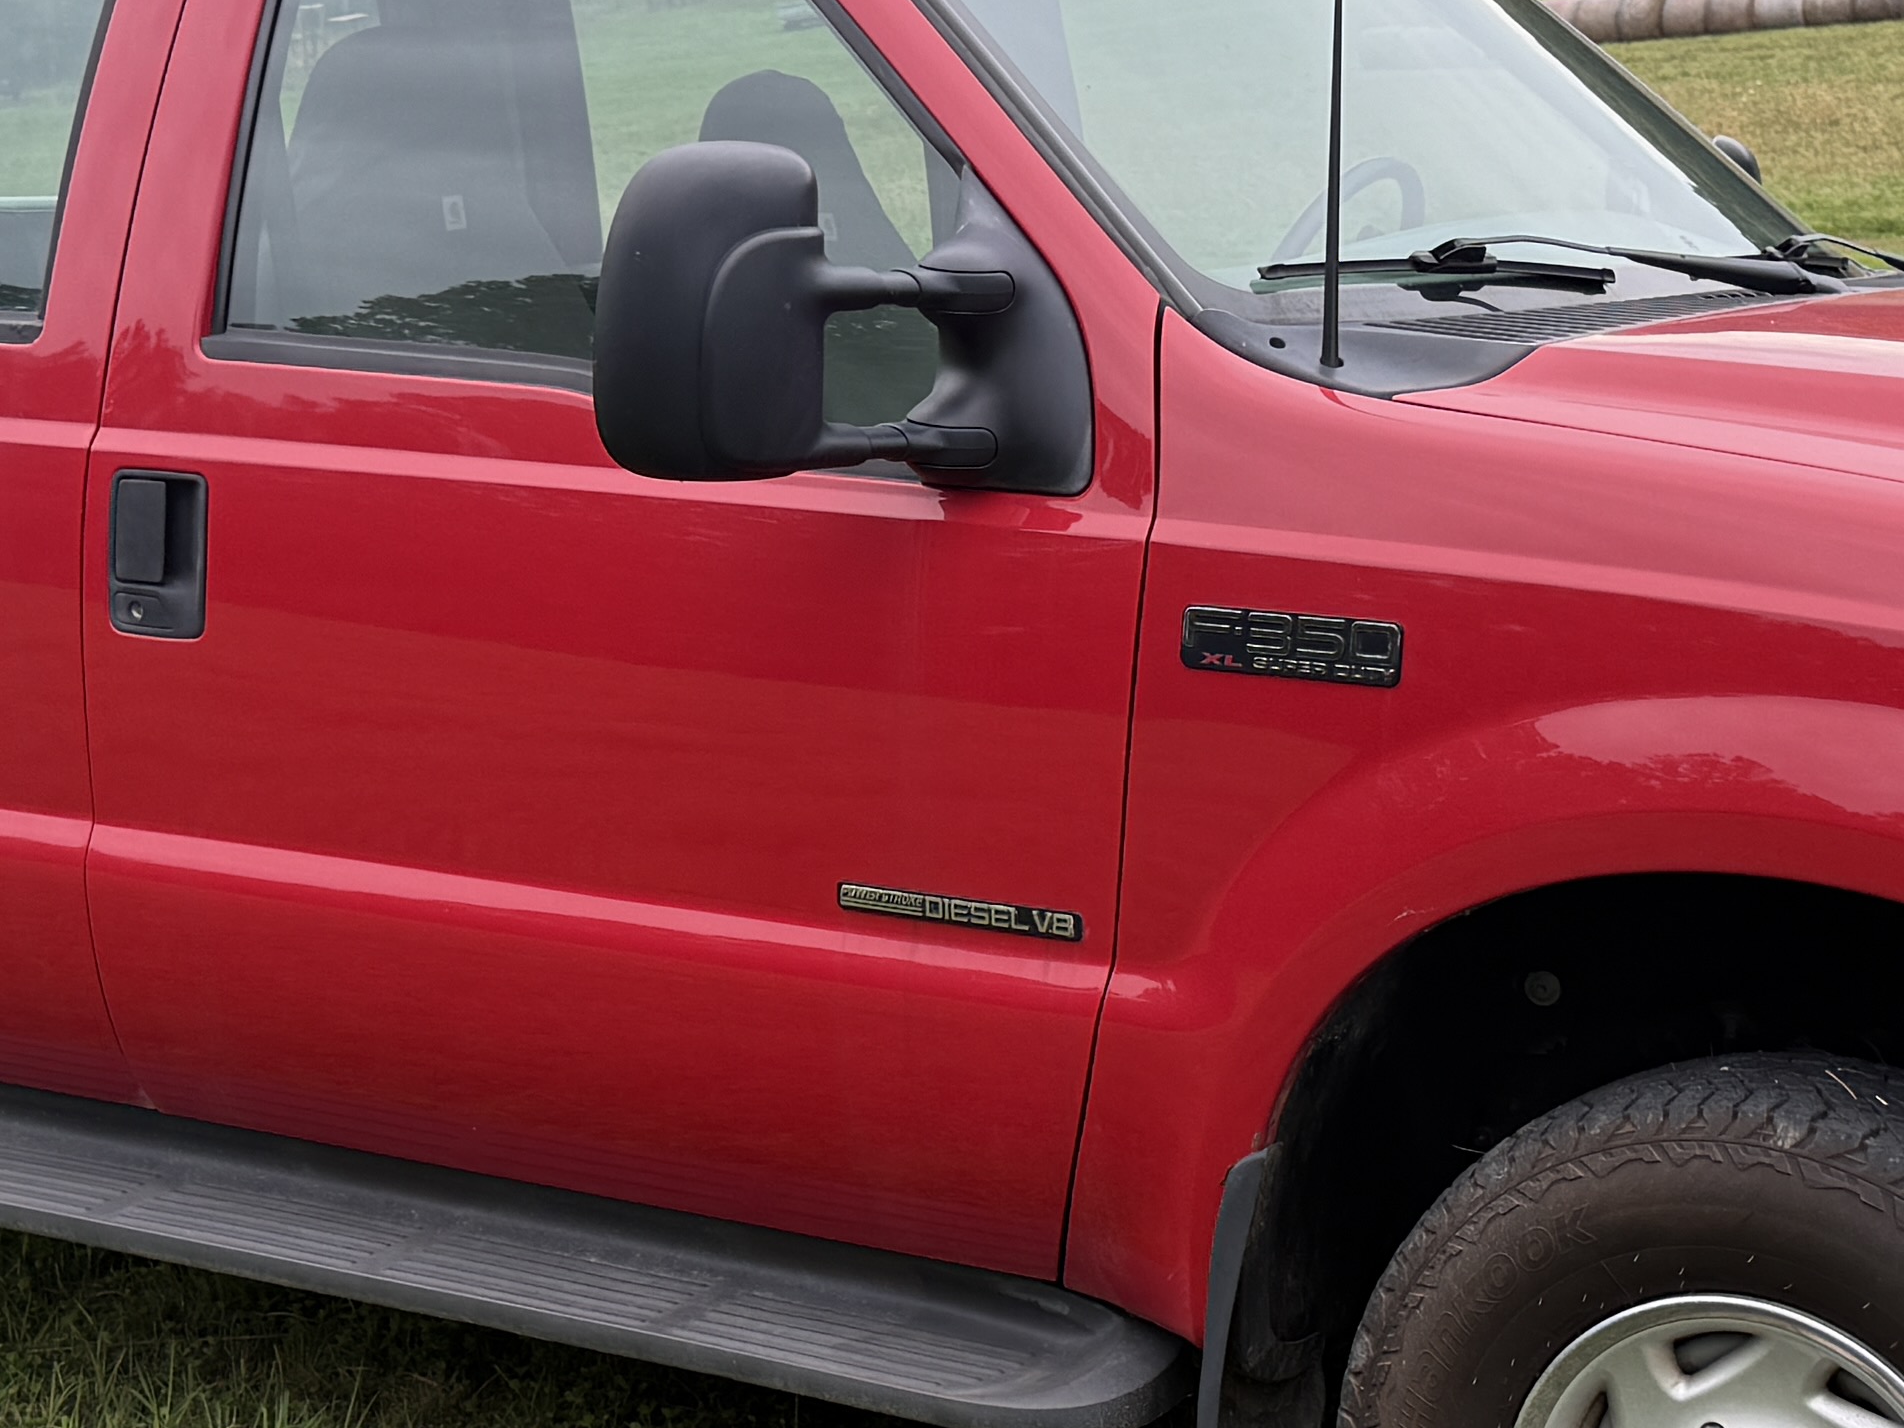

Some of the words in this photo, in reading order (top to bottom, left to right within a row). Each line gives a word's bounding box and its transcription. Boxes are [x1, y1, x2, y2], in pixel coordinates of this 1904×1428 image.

[1200, 652, 1242, 668] XL
[1252, 656, 1328, 677] SUPER
[1333, 664, 1396, 682] DUTY
[925, 896, 1030, 931] DIESEL
